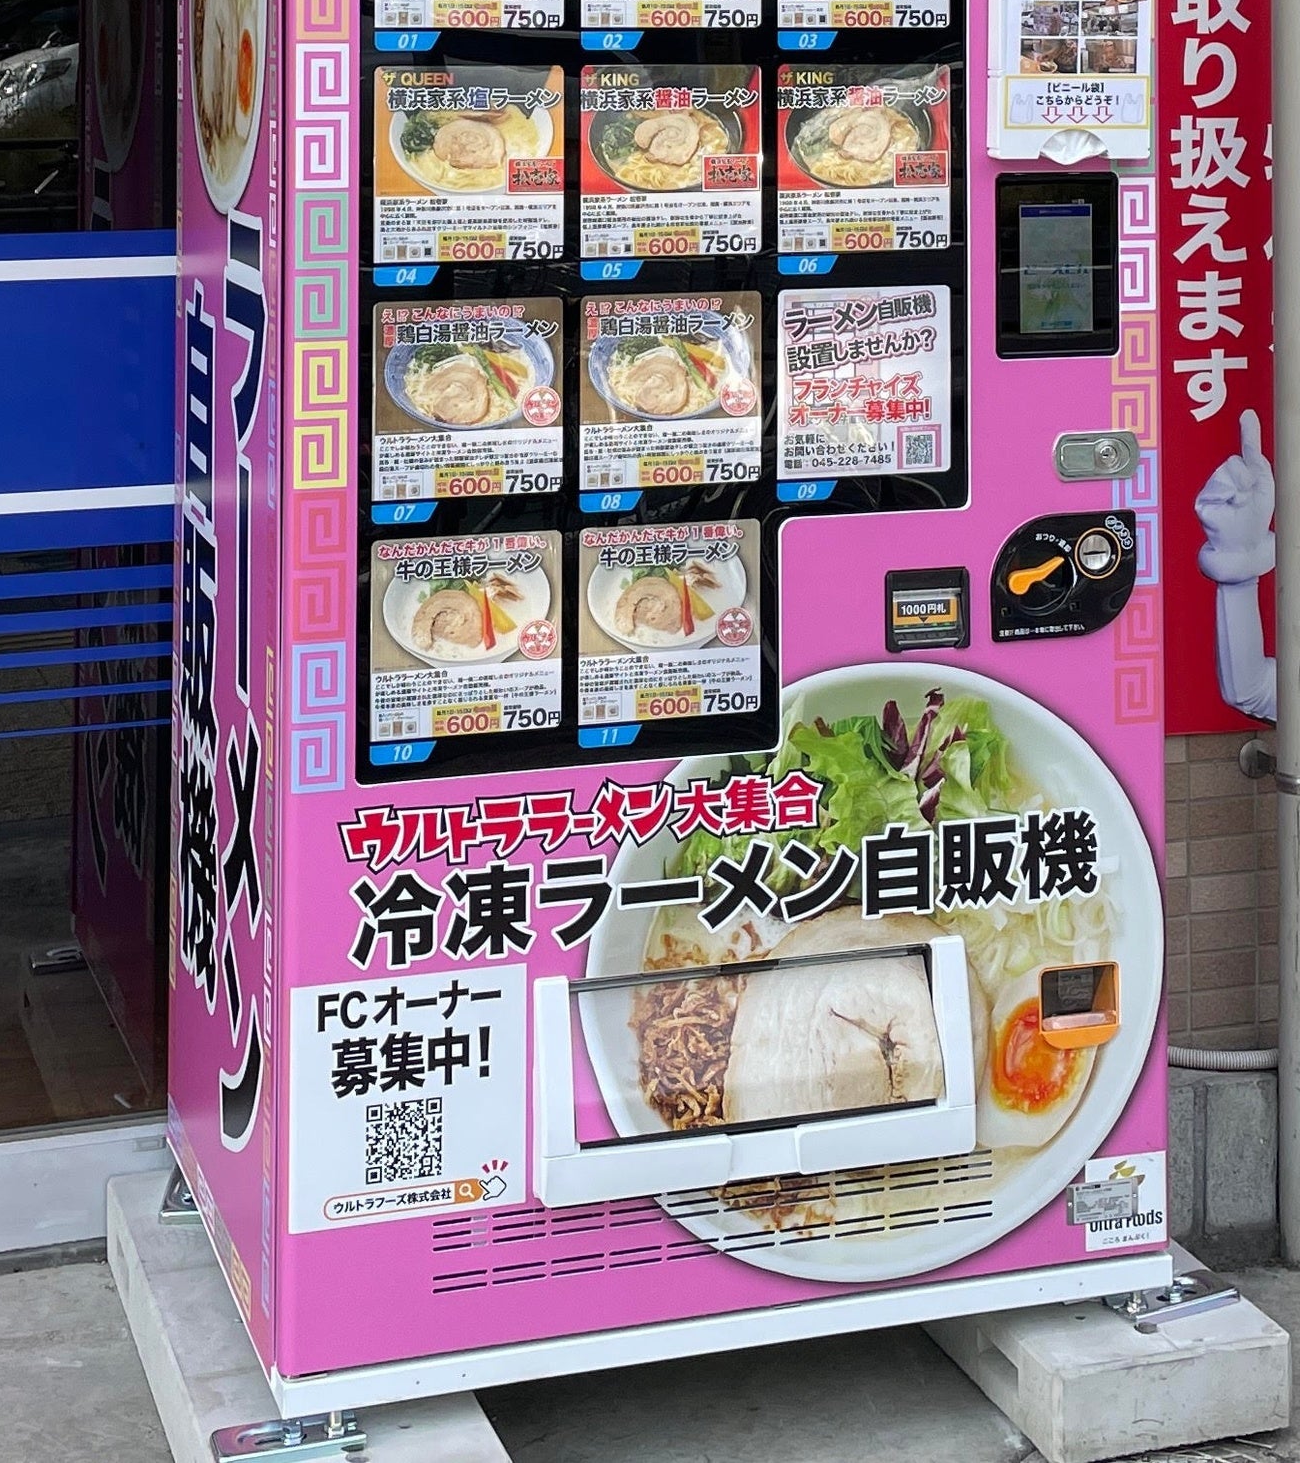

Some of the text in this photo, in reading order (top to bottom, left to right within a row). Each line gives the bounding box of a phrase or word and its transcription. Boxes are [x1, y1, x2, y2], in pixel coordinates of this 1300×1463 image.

[448, 10, 500, 27] 600円
[504, 10, 560, 28] 750円
[651, 10, 700, 27] 600円
[705, 10, 758, 27] 750円
[845, 10, 893, 27] 600円
[896, 10, 947, 27] 750円
[398, 34, 418, 49] 01
[602, 34, 623, 49] 02
[799, 34, 818, 48] 03
[382, 72, 454, 86] ザ QUEEN
[601, 73, 639, 87] KING
[796, 71, 834, 85] KING
[387, 88, 561, 111] 横浜家系塩ラーメン
[581, 88, 758, 111] 横浜家系醤油ラーメン
[648, 237, 699, 255] 600円
[702, 234, 757, 253] 750円
[844, 233, 894, 250] 600円
[896, 230, 948, 249] 750円
[452, 242, 506, 260] 600円
[509, 240, 564, 259] 750円
[602, 263, 622, 278] 05
[798, 258, 818, 273] 06
[396, 268, 417, 284] 04
[600, 313, 755, 337] 鶏白湯醤油ラーメン
[784, 293, 934, 339] ラーメン自販機
[397, 320, 559, 345] 鶏白湯醤油ラーメン
[787, 328, 934, 373] 設置しませんか?
[794, 374, 923, 402] フランチャイズ
[789, 398, 931, 427] オーナー募集中!
[784, 433, 826, 445] お気軽に
[653, 466, 703, 484] 600円
[706, 462, 760, 482] 750円
[449, 477, 503, 496] 600円
[505, 473, 562, 493] 750円
[797, 484, 817, 499] 09
[601, 494, 621, 510] 08
[394, 505, 416, 521] 07
[599, 542, 740, 568] 牛の王様ラーメン
[396, 553, 543, 581] 牛の王様ラーメン
[900, 603, 947, 616] 1000円札
[179, 279, 218, 1015] 自販機
[220, 208, 268, 1152] ラーメン
[649, 697, 700, 716] 600円
[704, 692, 758, 712] 750円
[447, 713, 500, 734] 600円
[503, 708, 561, 729] 750円
[602, 729, 619, 744] 11
[393, 745, 413, 762] 10
[343, 771, 824, 868] ウルトララーメン大集合
[353, 812, 1102, 966] 冷凍ラーメン自販機
[317, 980, 501, 1032] FCオーナー
[331, 1026, 491, 1099] 募集中!
[334, 1188, 452, 1215] ウルトラフーズ株式会社
